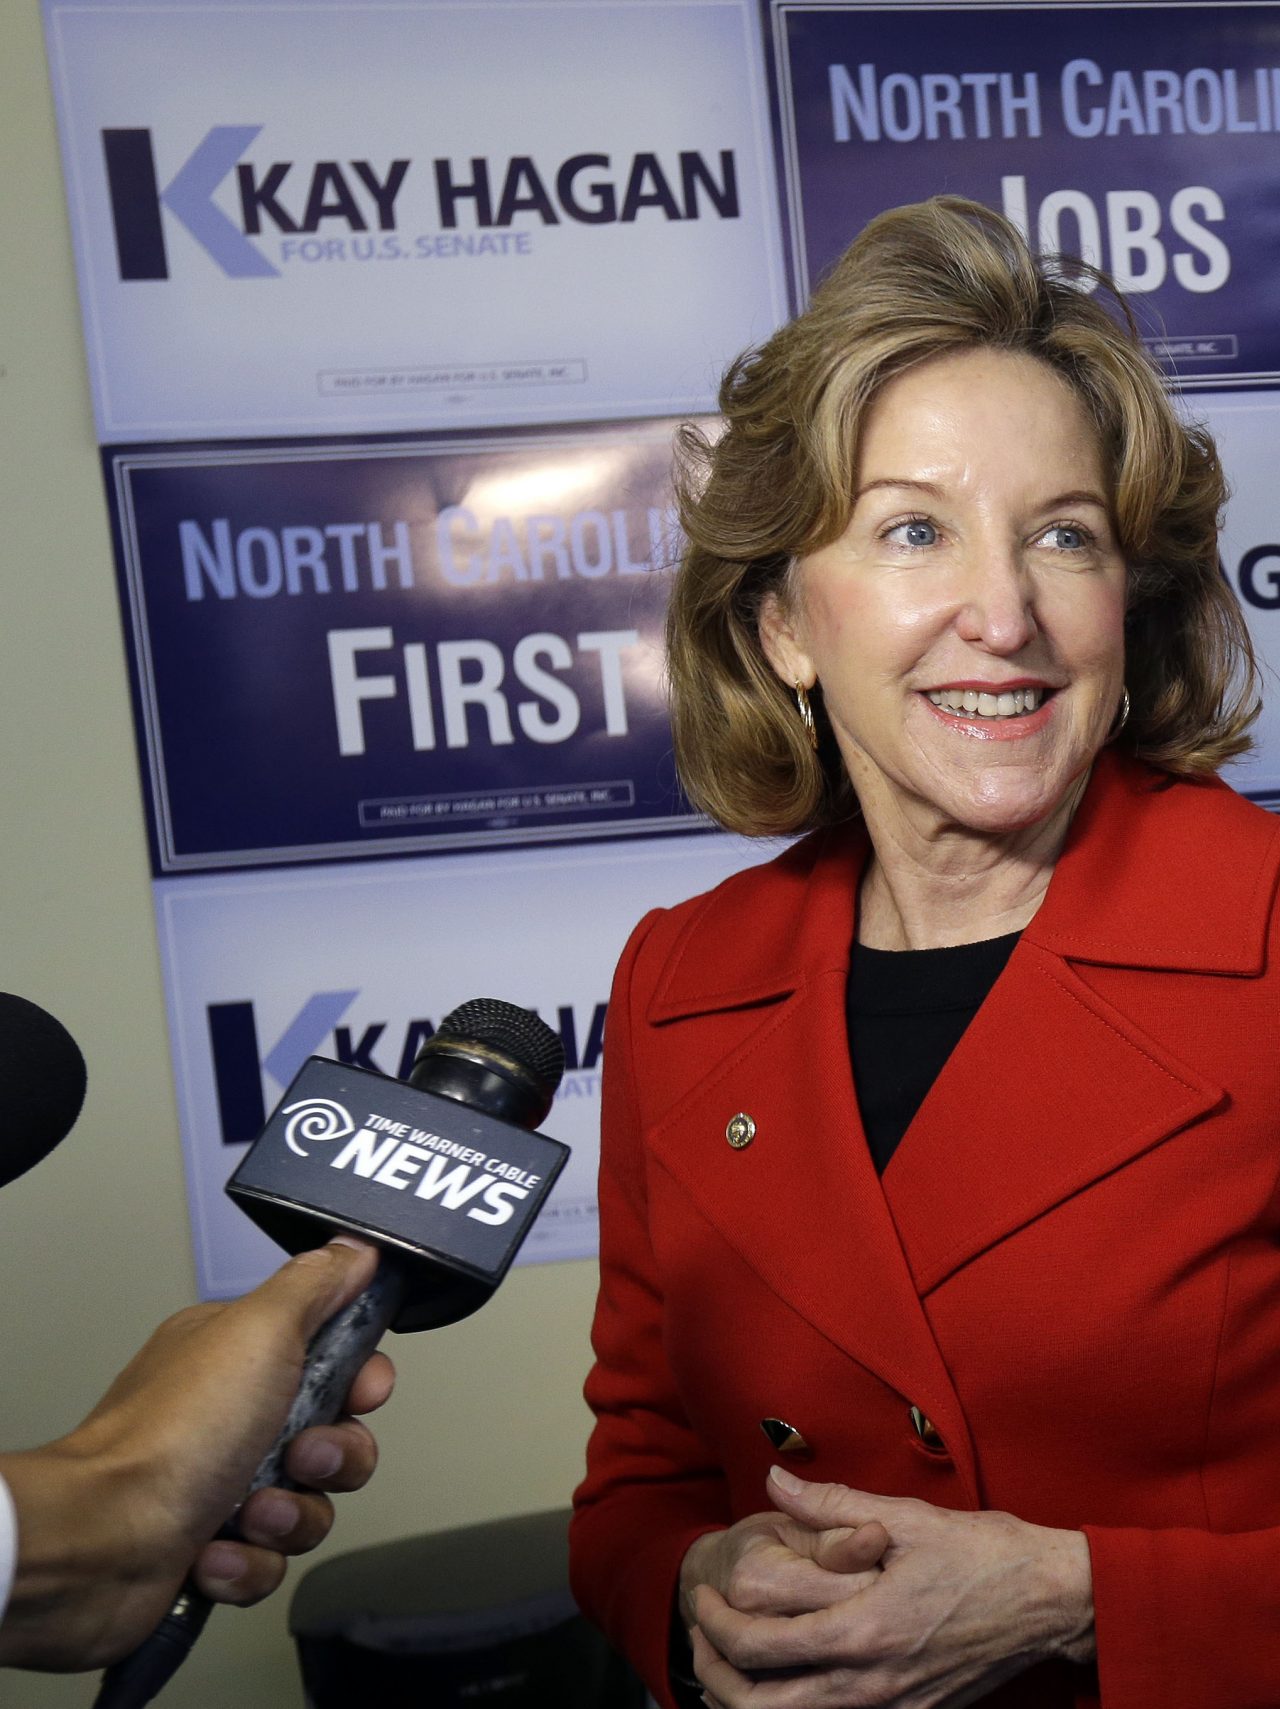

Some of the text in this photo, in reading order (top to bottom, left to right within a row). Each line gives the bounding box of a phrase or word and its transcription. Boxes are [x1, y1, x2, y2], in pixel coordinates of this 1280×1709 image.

[829, 62, 1042, 144] NORTH
[237, 149, 741, 235] KAY HAGAN
[281, 232, 533, 263] FOR U.S. SENATE
[178, 504, 686, 601] NORTH CAROLI
[327, 626, 638, 757] FIRST
[329, 1128, 530, 1226] NEWS
[364, 1113, 542, 1189] TIME WARNER CABLE
